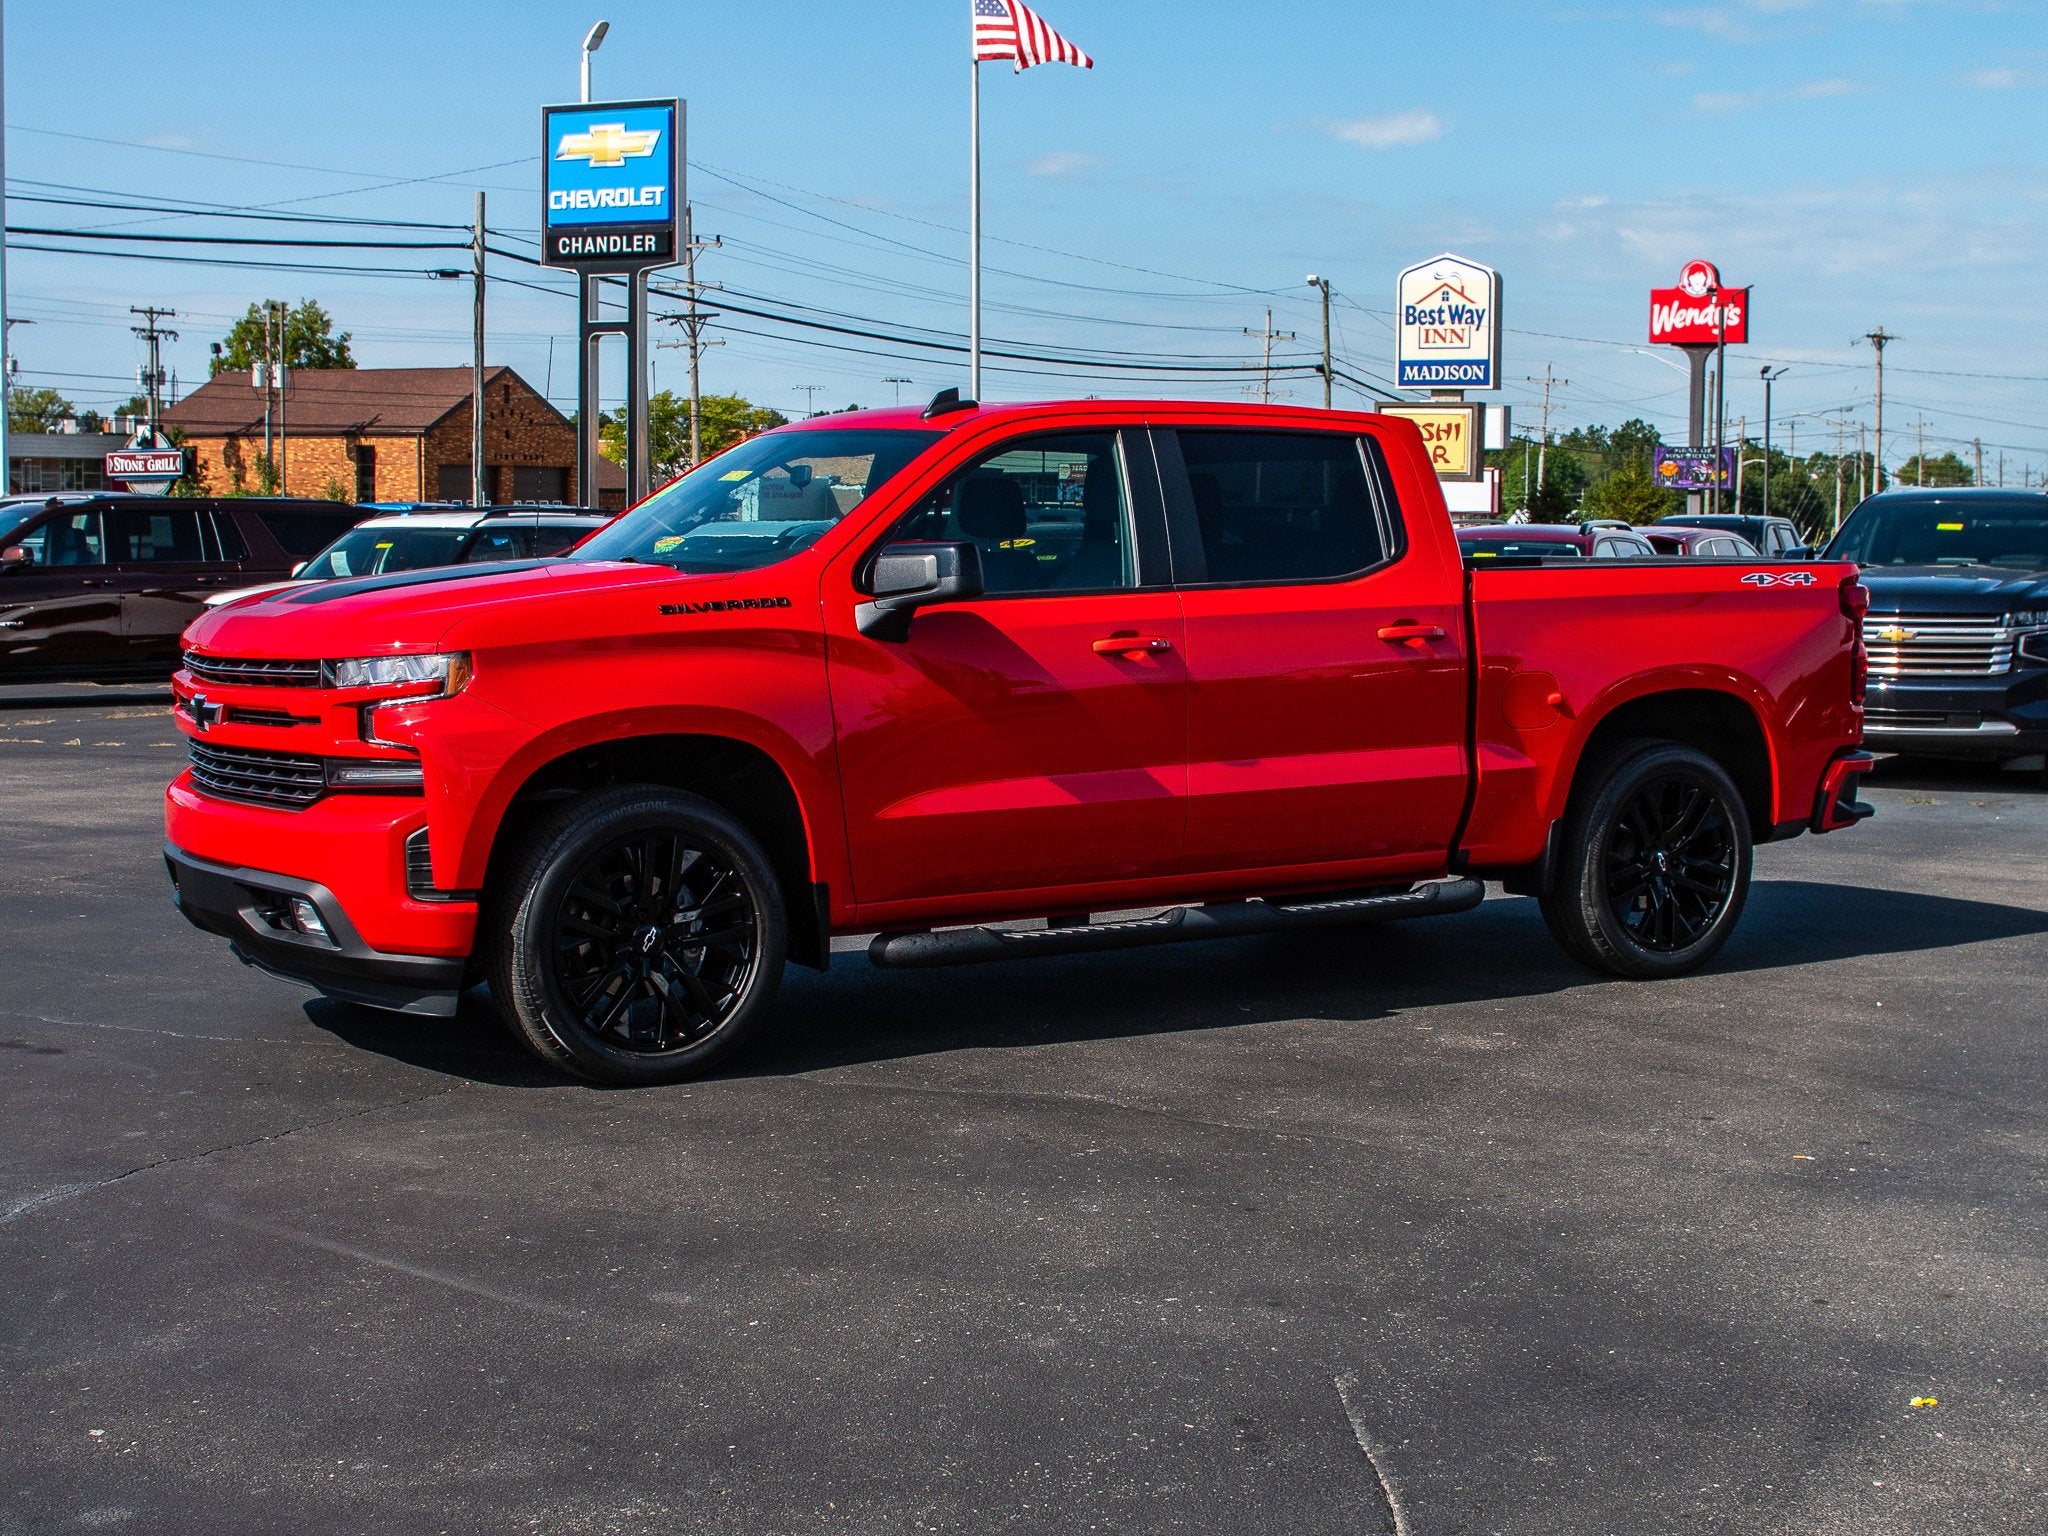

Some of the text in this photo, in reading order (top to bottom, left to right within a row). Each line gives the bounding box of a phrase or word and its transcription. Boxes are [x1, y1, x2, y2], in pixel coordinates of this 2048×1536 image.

[549, 186, 665, 210] CHEVROLET
[558, 235, 656, 254] CHANDLER
[1405, 304, 1486, 331] Best Way
[1653, 296, 1741, 336] Wendy's
[1423, 328, 1465, 344] INN
[1403, 365, 1485, 381] MADISON
[1416, 422, 1461, 441] SHI
[113, 457, 176, 472] STONE GRILL
[658, 597, 792, 615] SILVERADO
